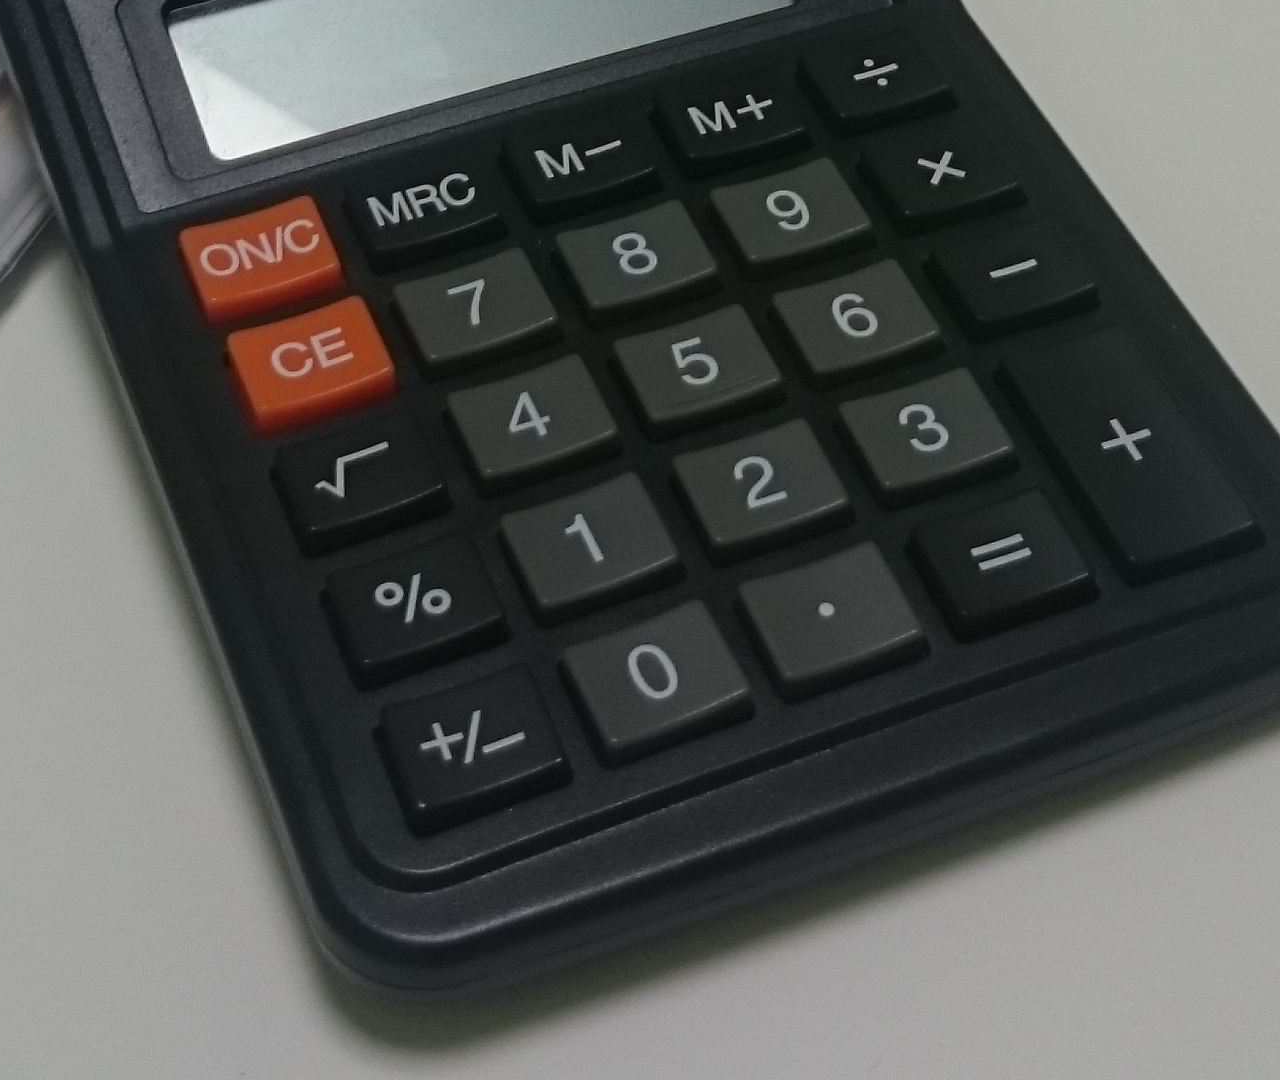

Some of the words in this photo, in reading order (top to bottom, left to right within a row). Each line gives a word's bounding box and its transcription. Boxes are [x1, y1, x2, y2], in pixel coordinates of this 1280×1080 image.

[686, 93, 774, 136] M+
[365, 172, 476, 228] MRC
[764, 188, 811, 231] 9
[199, 218, 320, 278] ON/C
[611, 231, 659, 276] 8
[446, 278, 487, 327] 7
[830, 292, 879, 339] 6
[270, 326, 354, 378] CE
[670, 336, 720, 386] 5
[508, 390, 551, 437] 4
[898, 403, 950, 453] 3
[732, 455, 788, 510] 2
[564, 512, 605, 563] 1
[626, 643, 680, 700] 0
